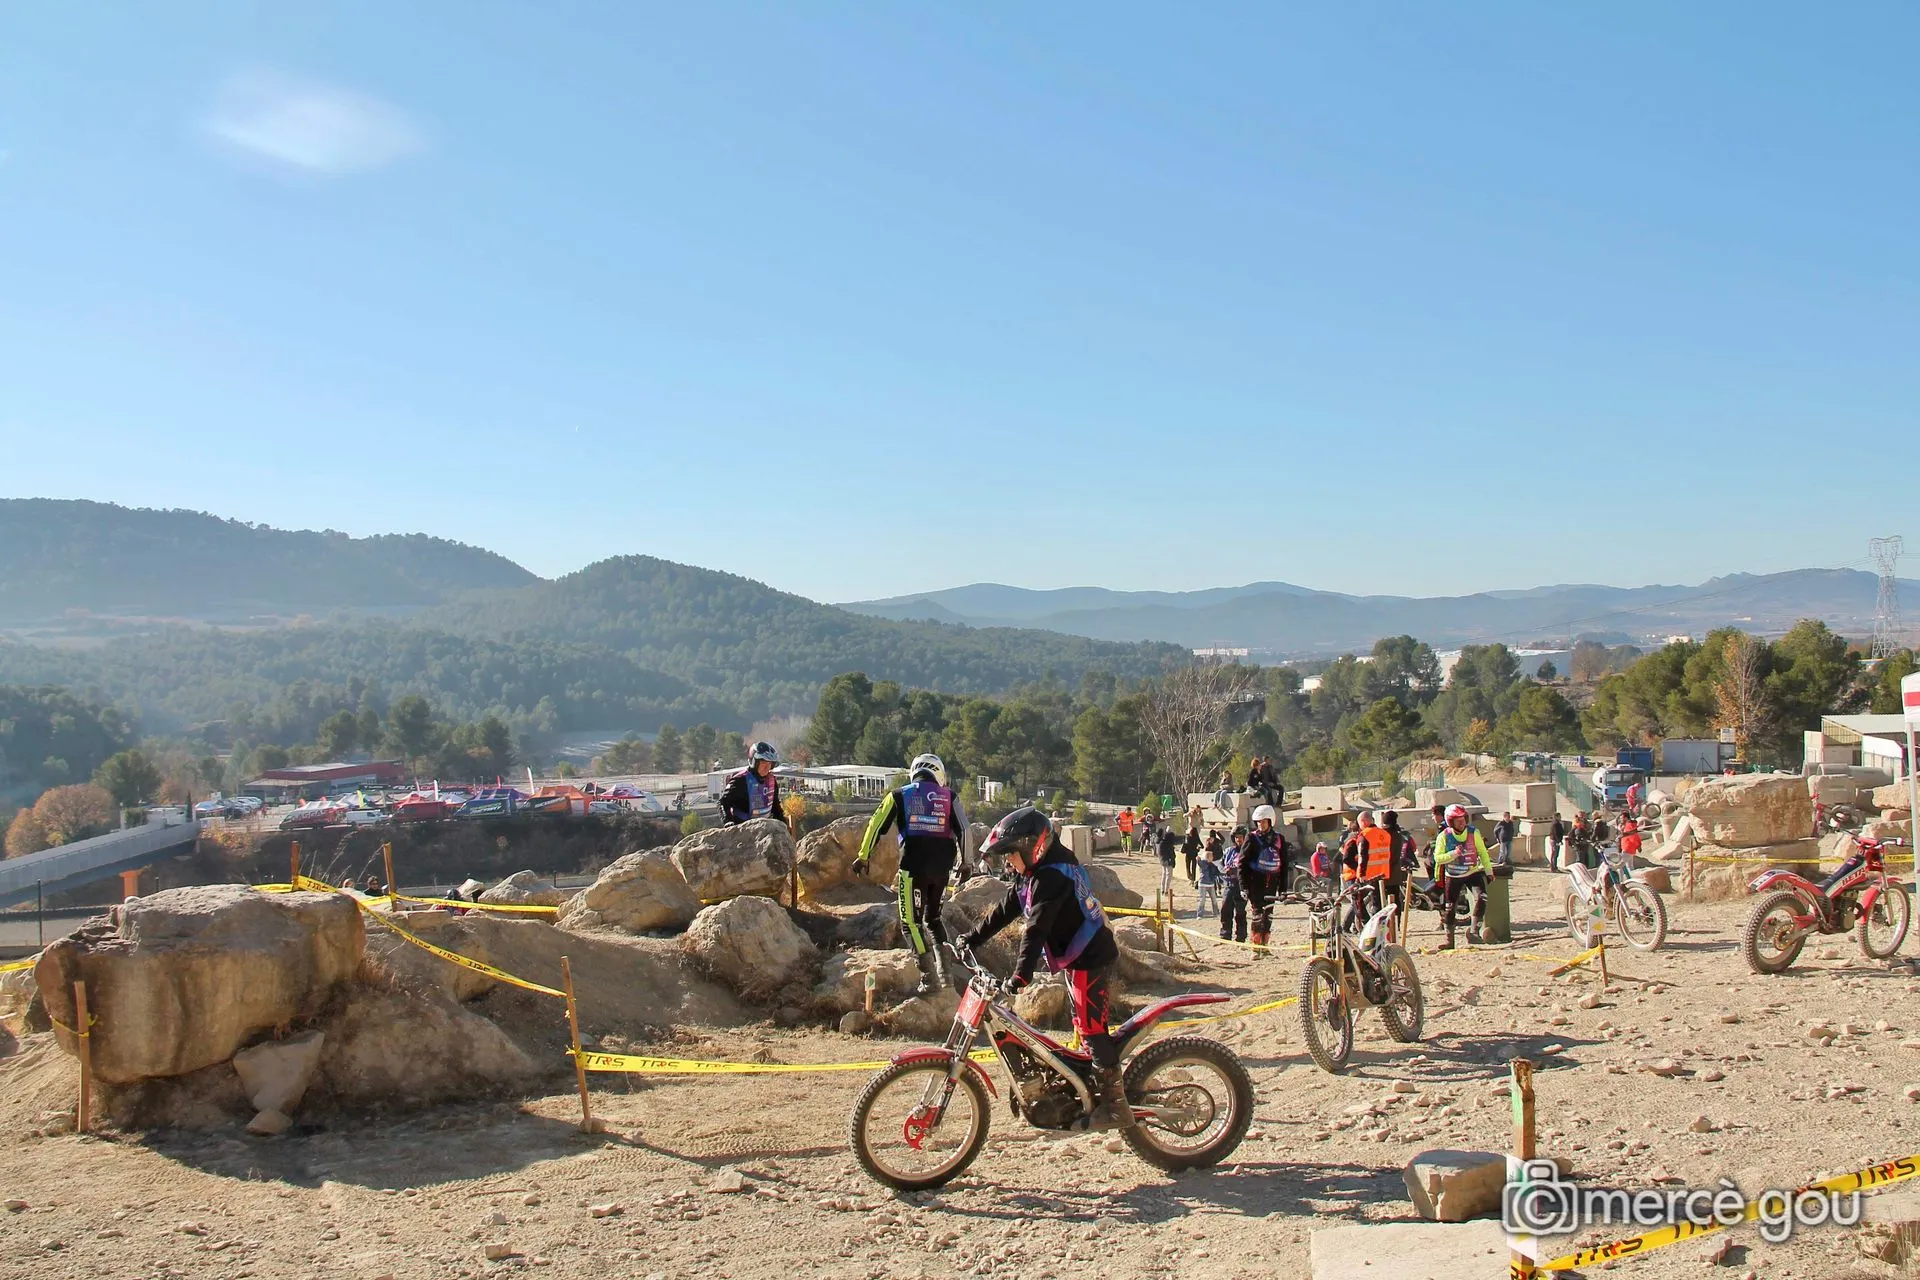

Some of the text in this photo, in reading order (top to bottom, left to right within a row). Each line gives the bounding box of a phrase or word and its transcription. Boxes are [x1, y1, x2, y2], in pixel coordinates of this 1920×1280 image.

[585, 1054, 626, 1067] TRS
[640, 1059, 680, 1068] TRS
[1847, 1156, 1916, 1188] TRS
